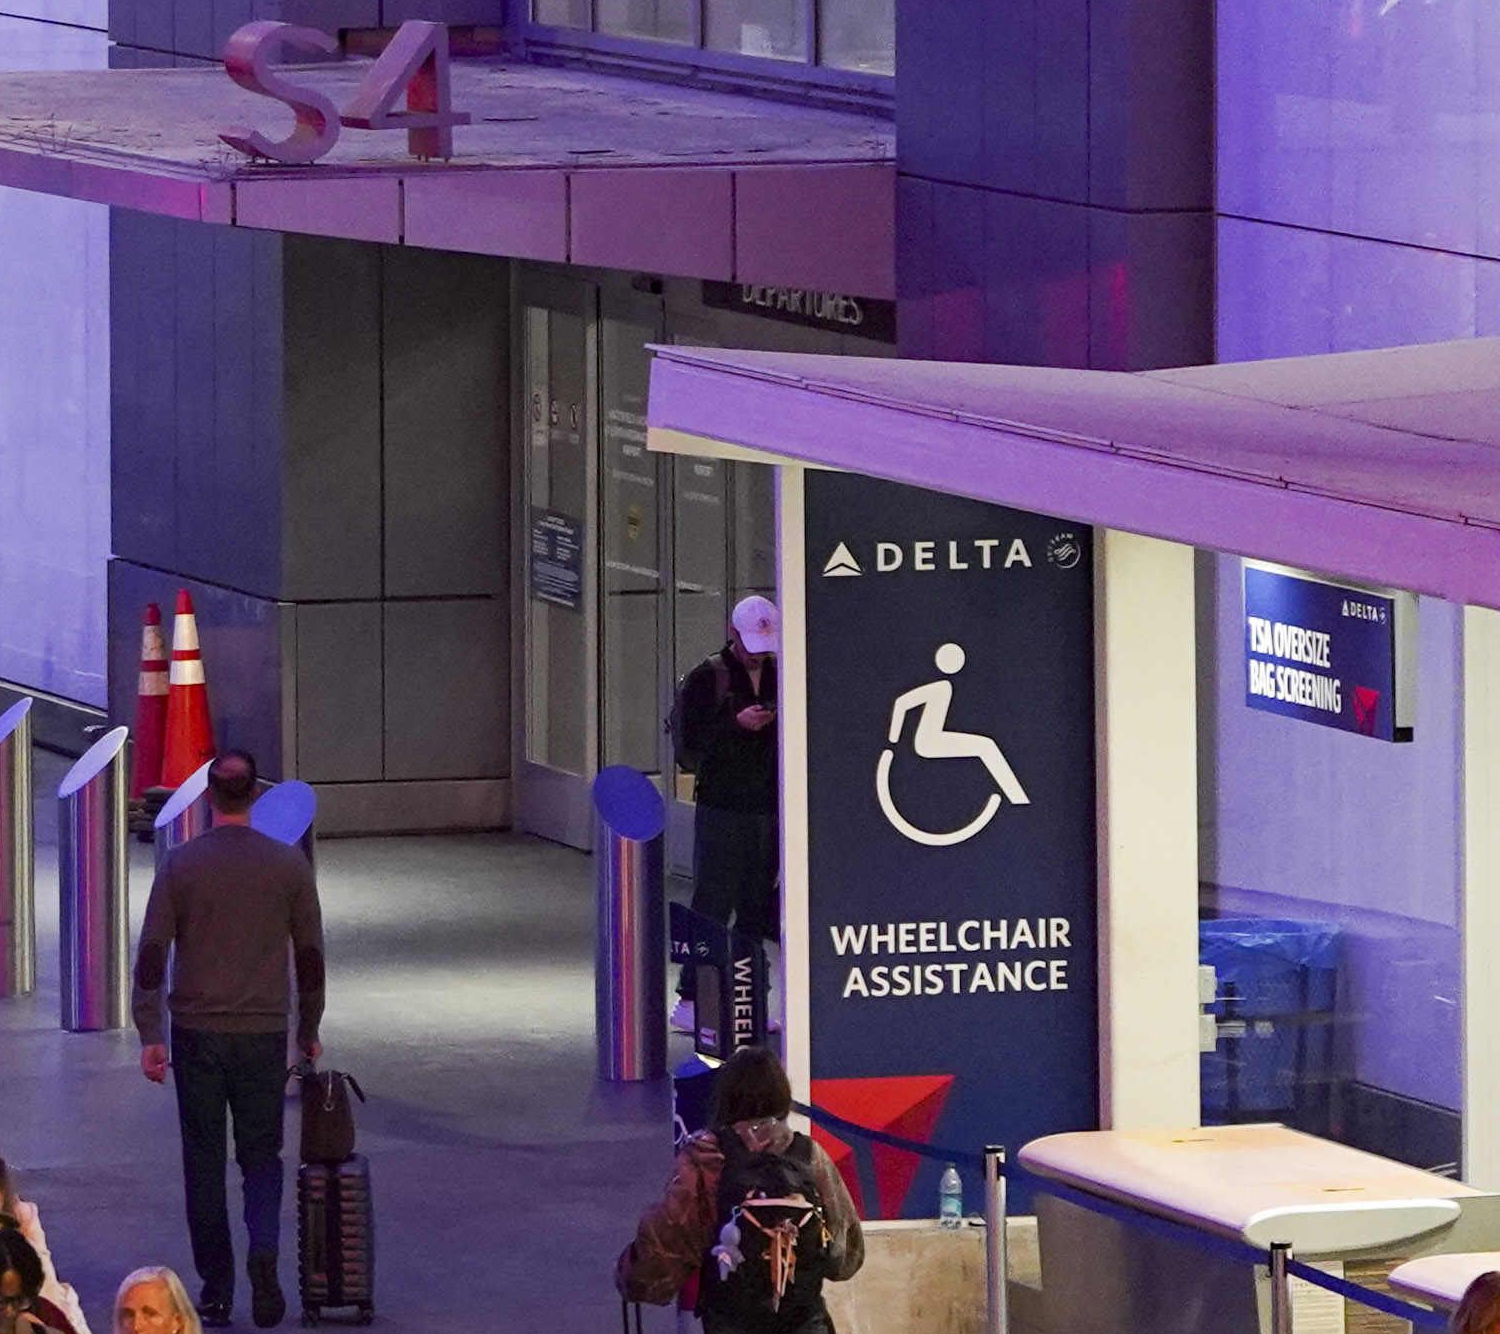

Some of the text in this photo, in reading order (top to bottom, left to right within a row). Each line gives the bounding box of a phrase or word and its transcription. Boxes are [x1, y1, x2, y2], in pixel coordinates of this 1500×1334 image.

[218, 20, 472, 164] S4
[876, 538, 1033, 572] DELTA
[1349, 601, 1379, 622] DELTA
[1248, 616, 1332, 669] TSA OVERSIZE
[1249, 658, 1342, 715] BAG SCREENING
[830, 917, 1073, 956] WHEELCHAIR
[842, 959, 1069, 998] ASSISTANCE
